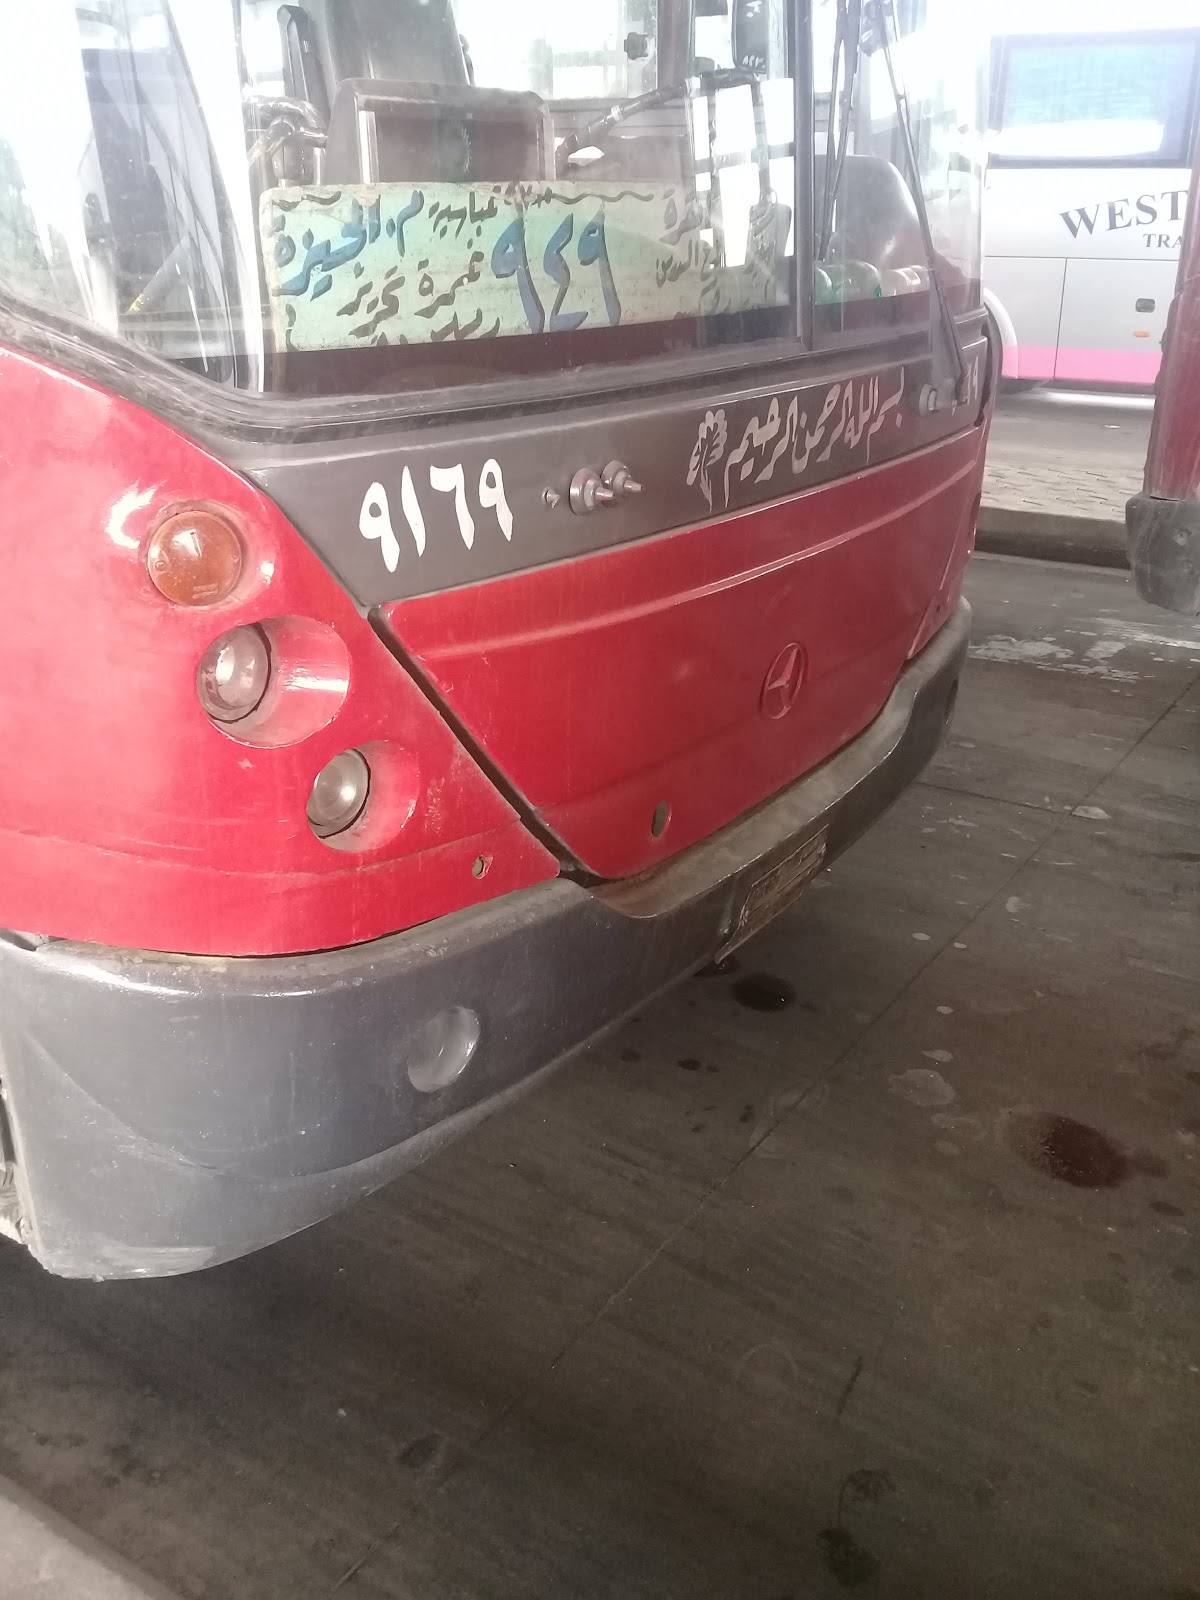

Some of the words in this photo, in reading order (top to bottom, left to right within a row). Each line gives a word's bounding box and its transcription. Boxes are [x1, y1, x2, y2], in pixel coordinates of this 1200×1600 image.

[723, 394, 799, 508] الرحيم
[791, 379, 853, 475] الرحمن
[843, 376, 879, 450] الله
[866, 366, 905, 465] بسم
[359, 458, 513, 573] ٩١٦٩
